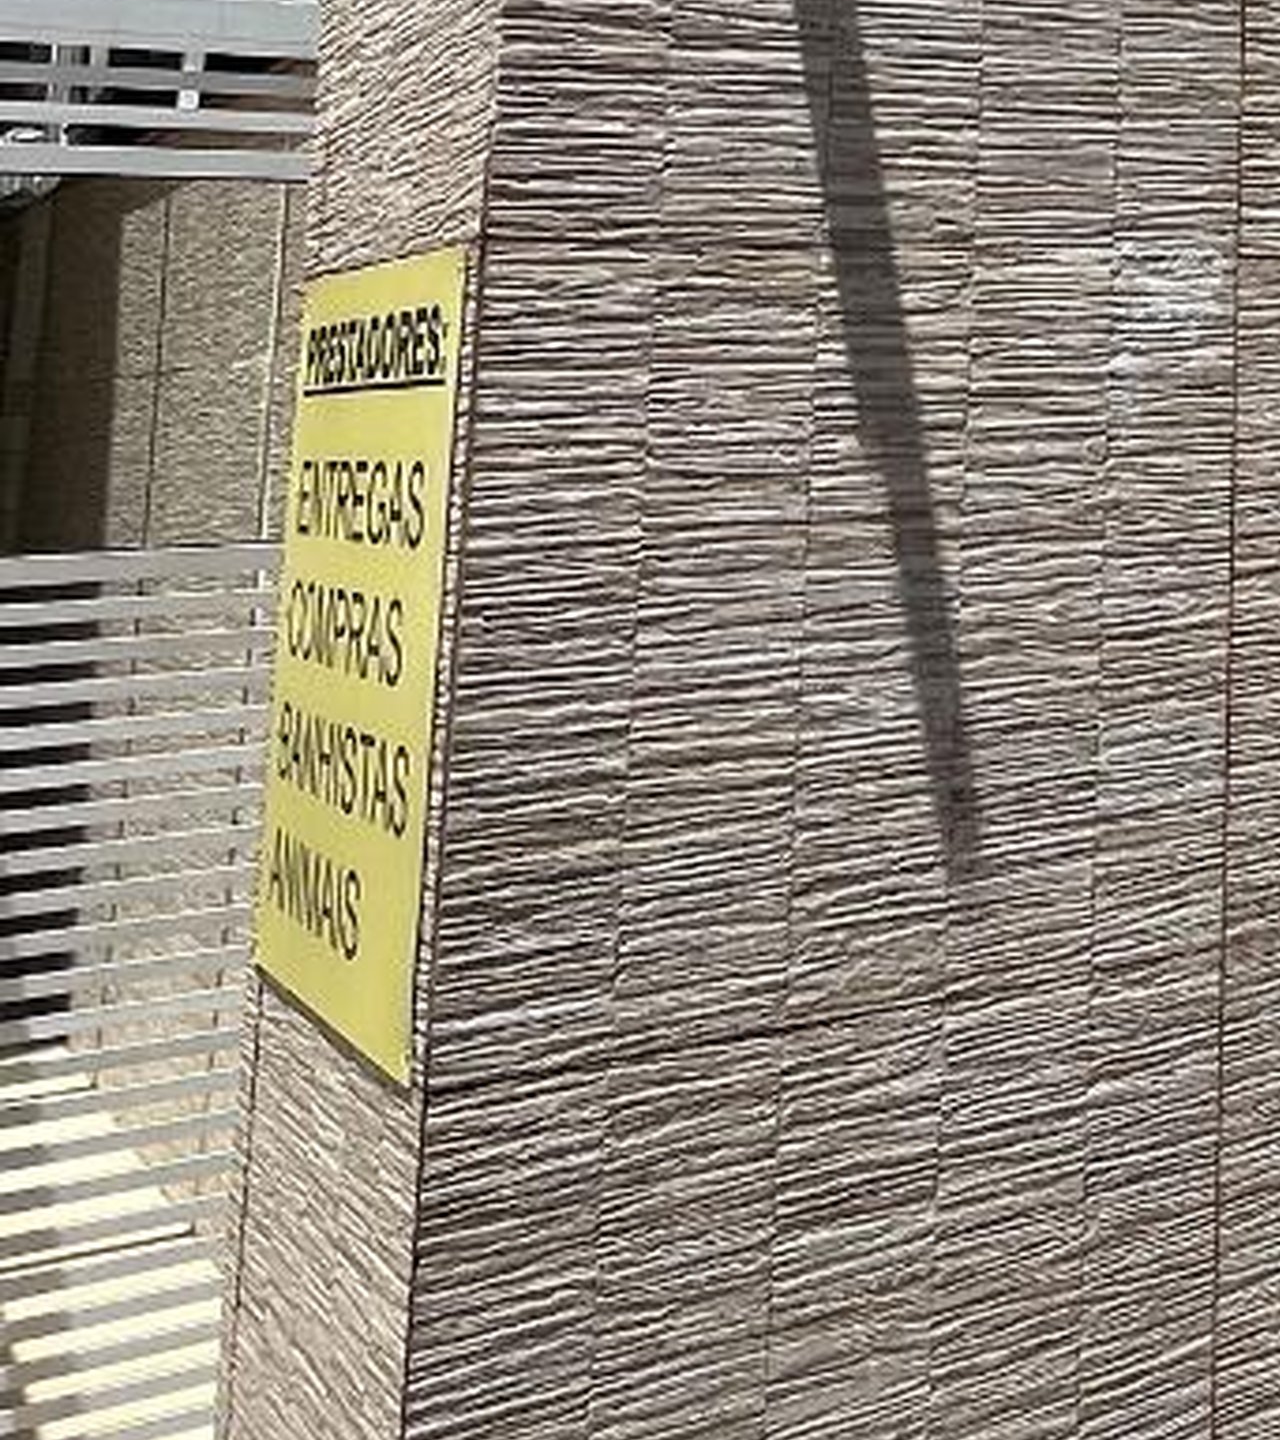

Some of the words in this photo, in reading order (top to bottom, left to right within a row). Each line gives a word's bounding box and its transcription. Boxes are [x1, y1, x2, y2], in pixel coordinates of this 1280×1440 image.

[297, 458, 426, 552] ENTREGAS
[287, 580, 404, 688] COMPRAS
[277, 701, 411, 840] BANHISTAS
[266, 827, 363, 962] ANIMAIS
